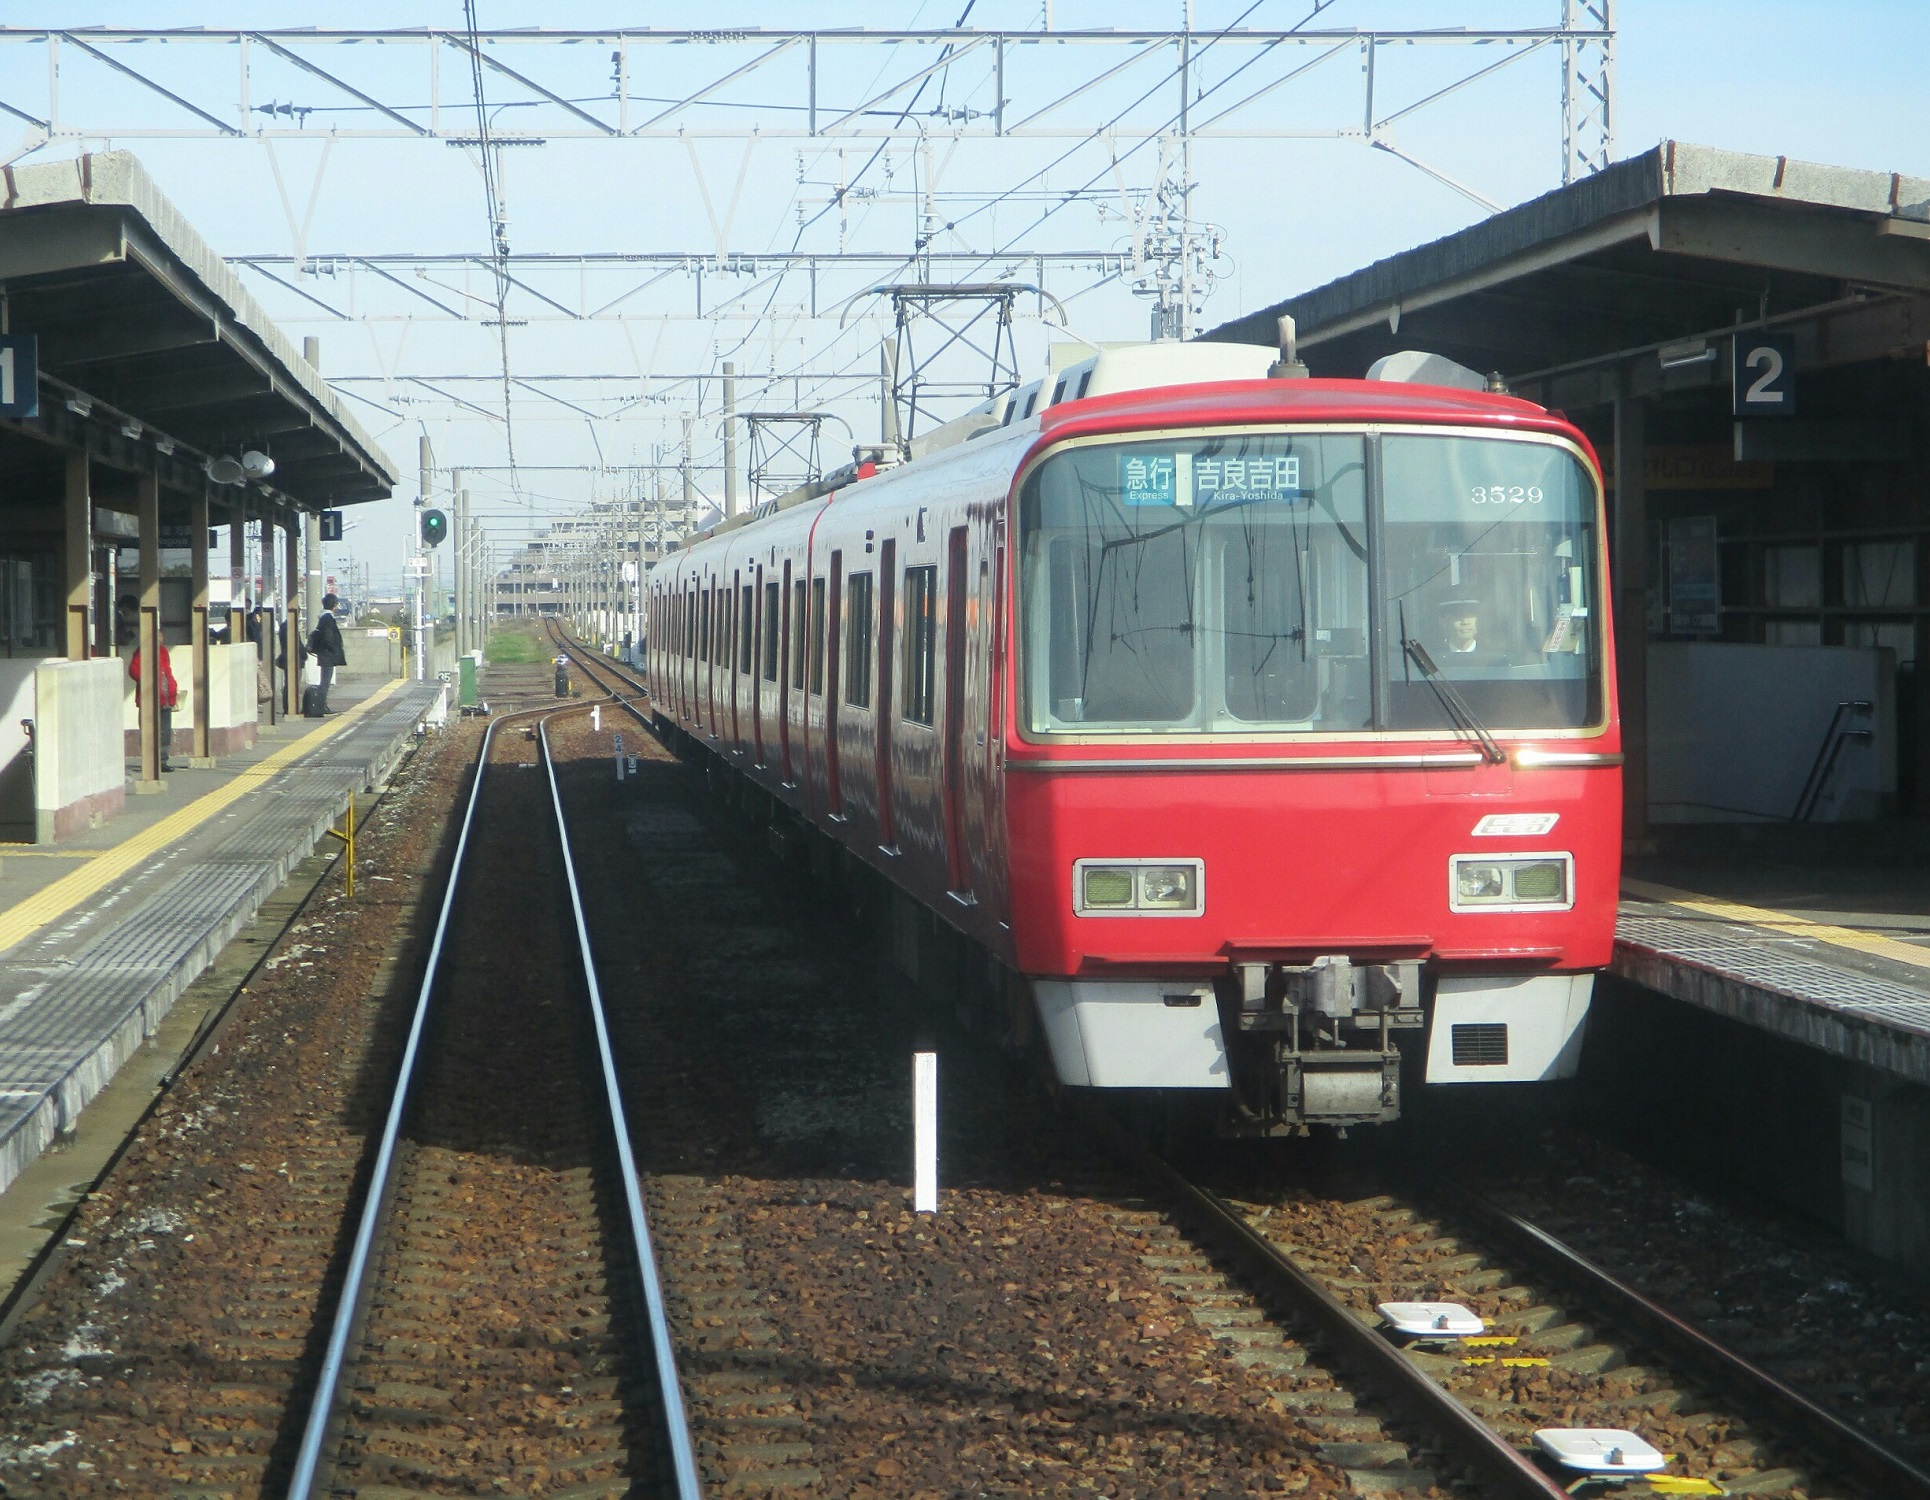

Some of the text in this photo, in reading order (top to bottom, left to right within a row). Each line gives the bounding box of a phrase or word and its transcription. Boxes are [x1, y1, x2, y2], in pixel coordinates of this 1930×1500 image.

[0, 347, 15, 404] 1
[1745, 346, 1784, 403] 2
[1126, 457, 1172, 490] 急行
[1196, 457, 1299, 490] 吉良吉田
[1129, 491, 1169, 502] Express
[1213, 490, 1284, 500] Kira-Yoshida
[1471, 486, 1544, 504] 3529
[324, 515, 335, 537] 1
[615, 735, 622, 752] 24
